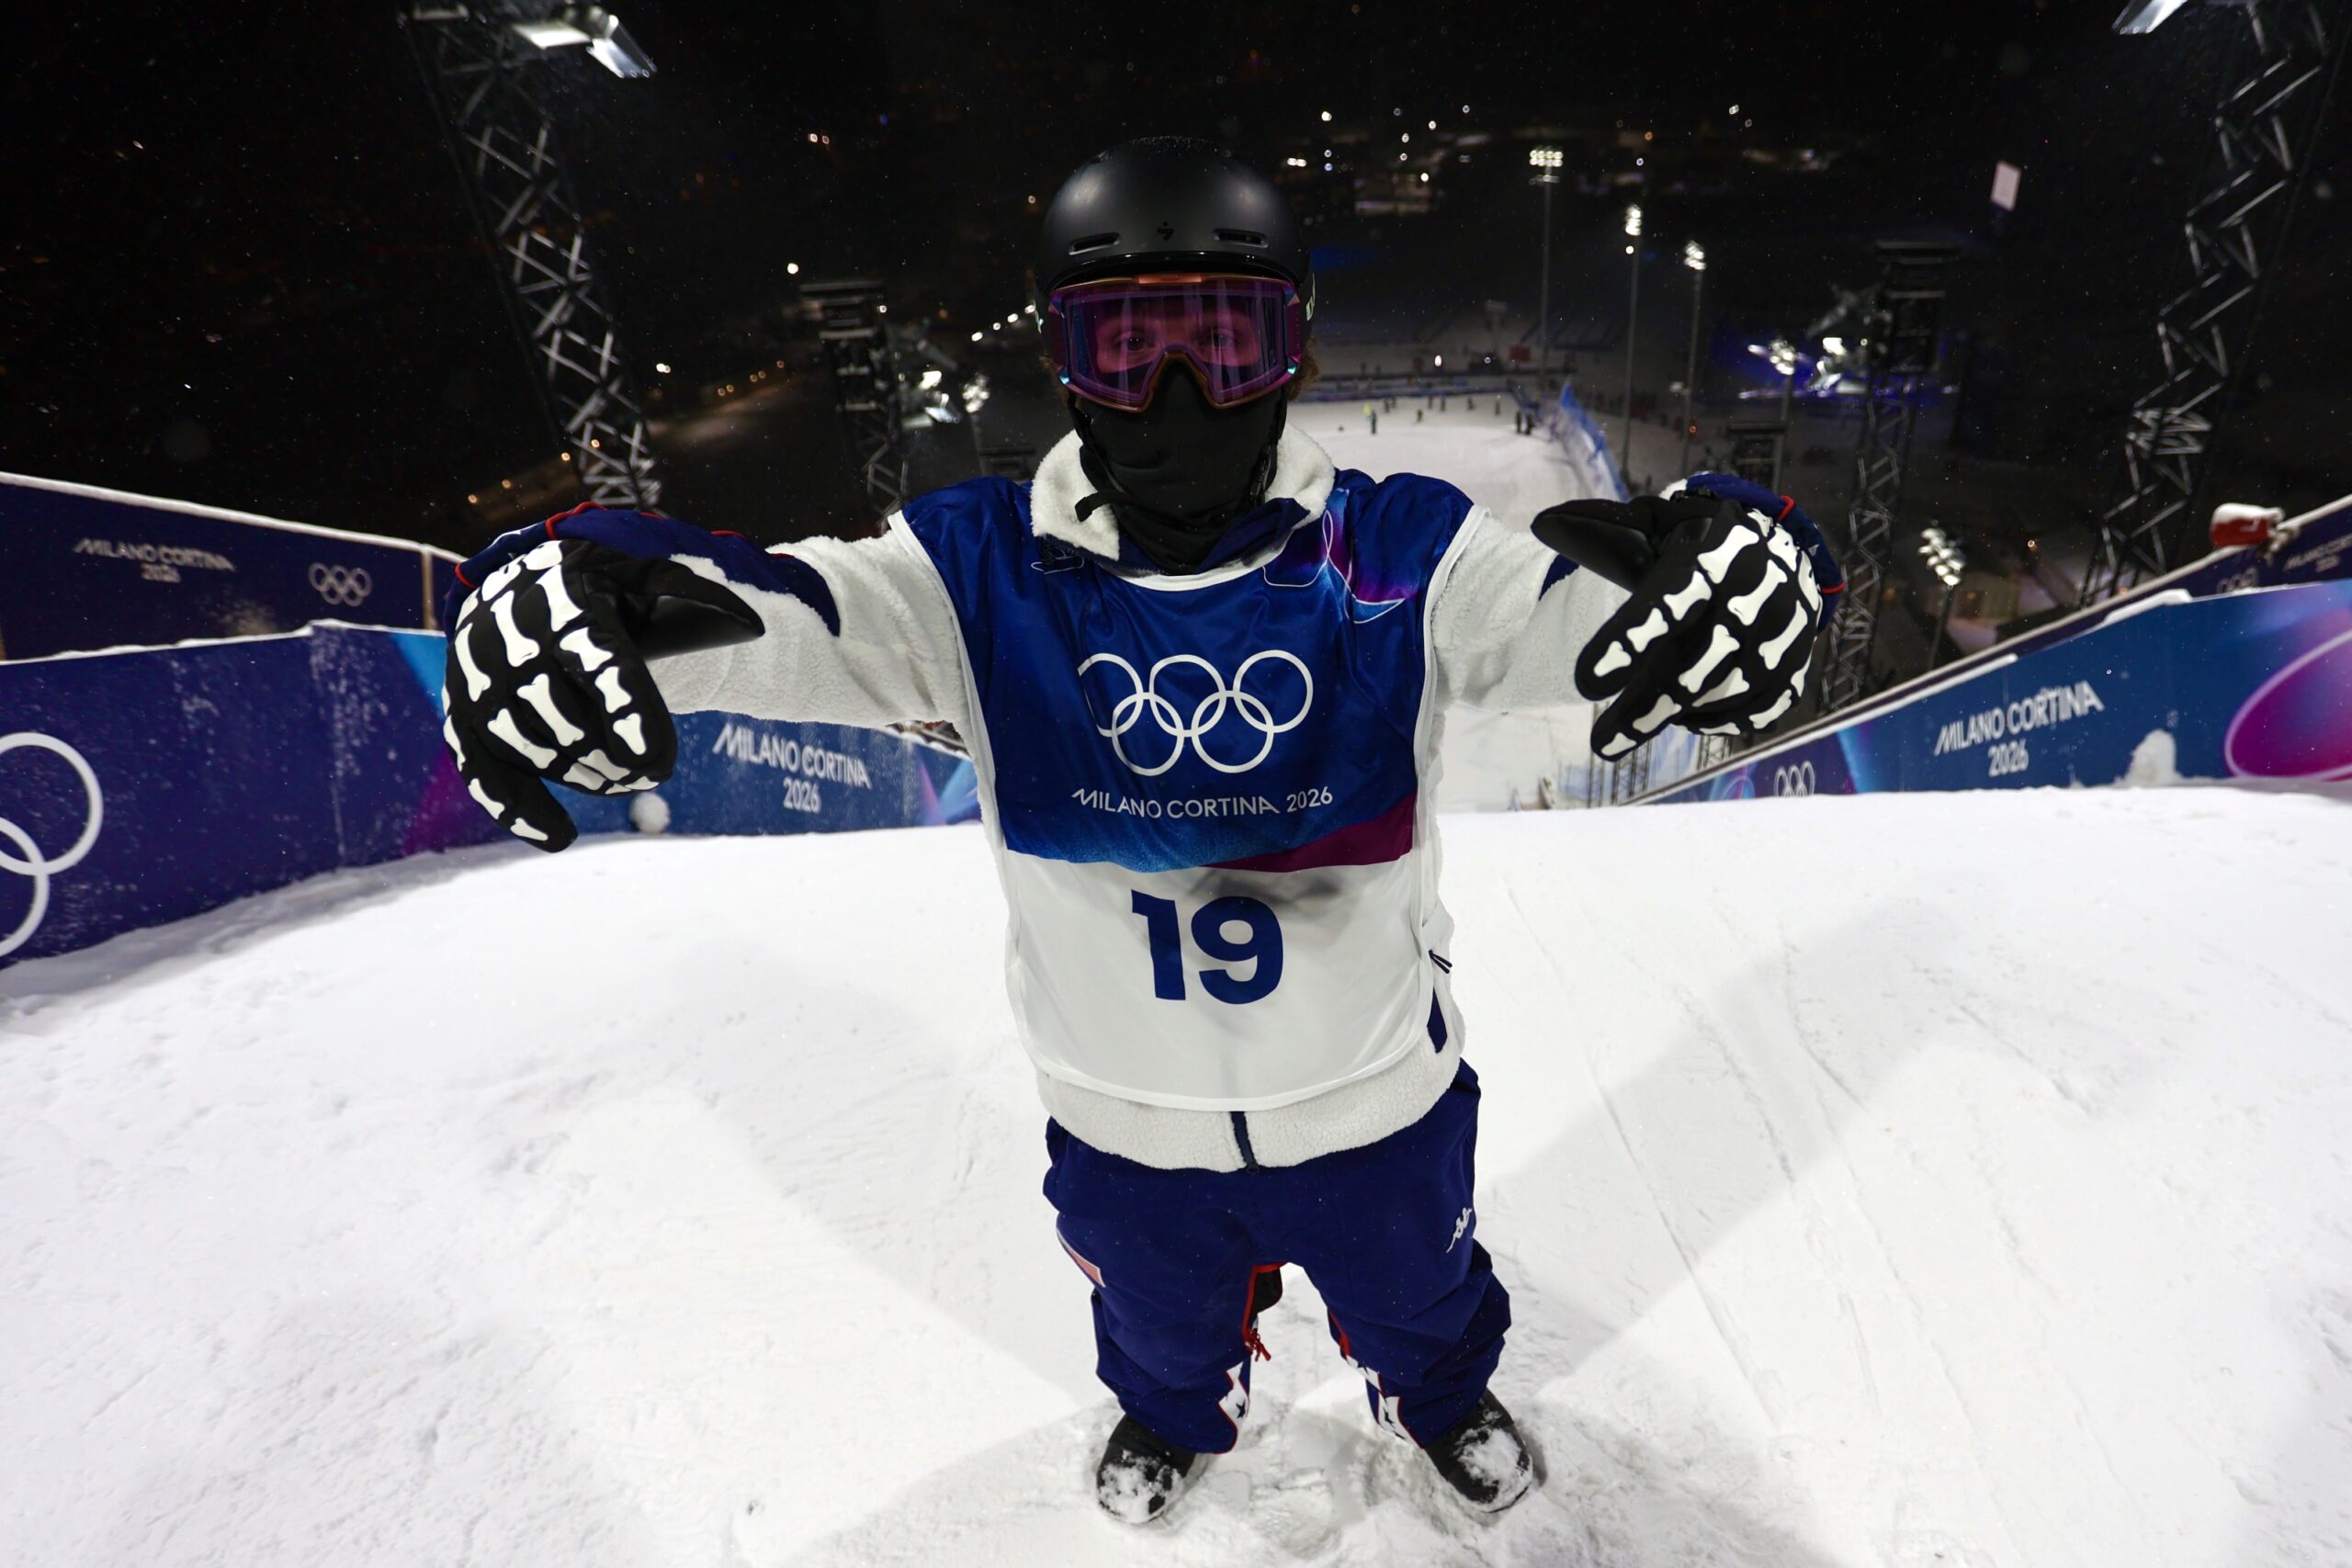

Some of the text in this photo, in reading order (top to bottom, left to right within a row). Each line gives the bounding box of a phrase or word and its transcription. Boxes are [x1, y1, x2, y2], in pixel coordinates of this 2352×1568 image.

[1934, 681, 2105, 756] MILANO CORTINA
[712, 723, 871, 790] MILANO CORTINA
[1987, 738, 2030, 777] 2026
[783, 777, 820, 814] 2026
[1071, 786, 1333, 818] MILANO CORTINA 2026
[1131, 888, 1283, 1005] 19
